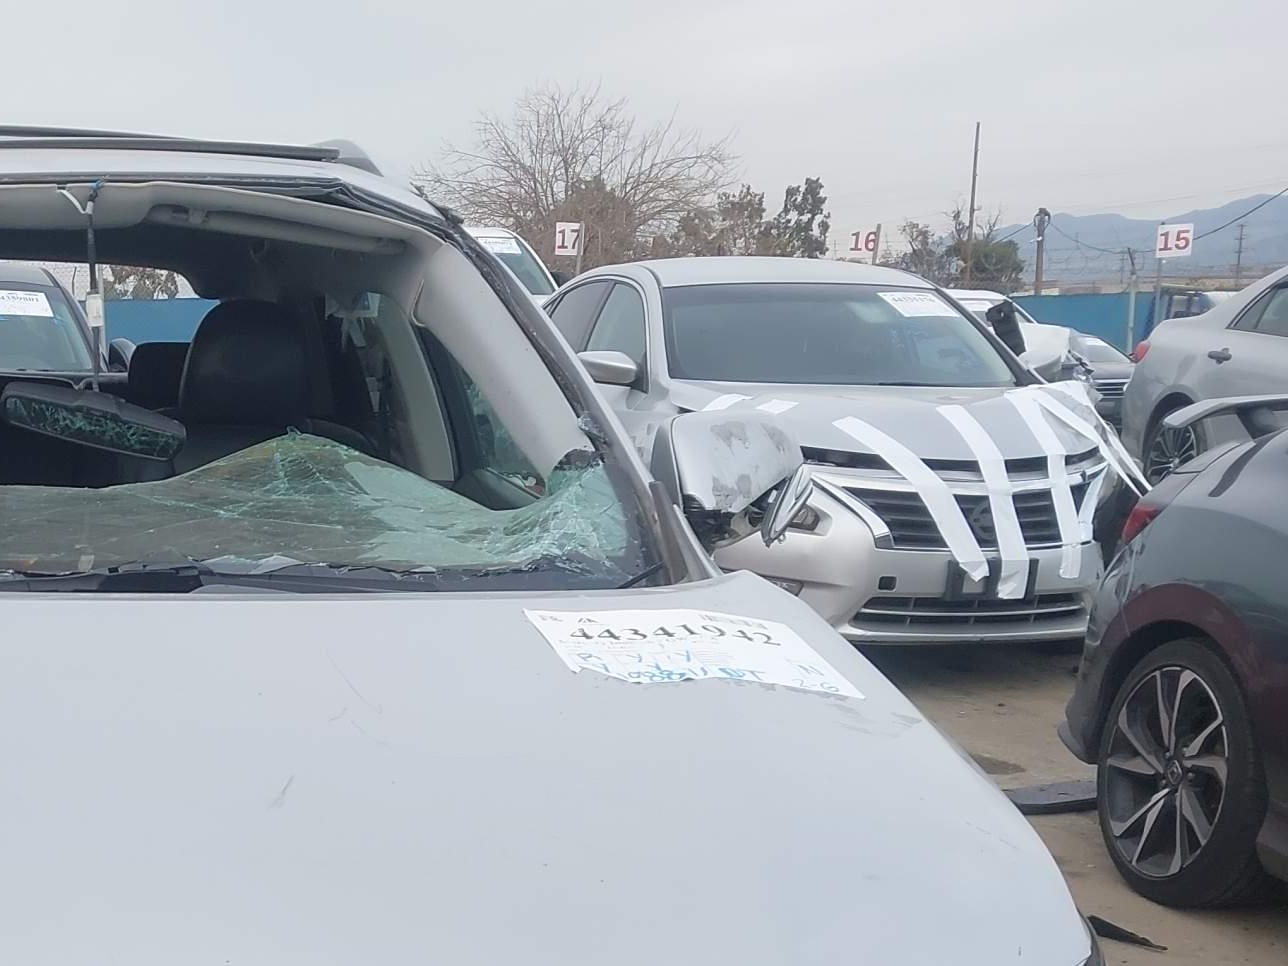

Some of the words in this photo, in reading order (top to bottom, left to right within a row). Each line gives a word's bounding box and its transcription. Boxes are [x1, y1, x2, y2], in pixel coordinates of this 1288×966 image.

[556, 228, 580, 250] 17
[849, 231, 878, 251] 16
[1158, 229, 1191, 251] 15
[569, 623, 781, 647] 44341942
